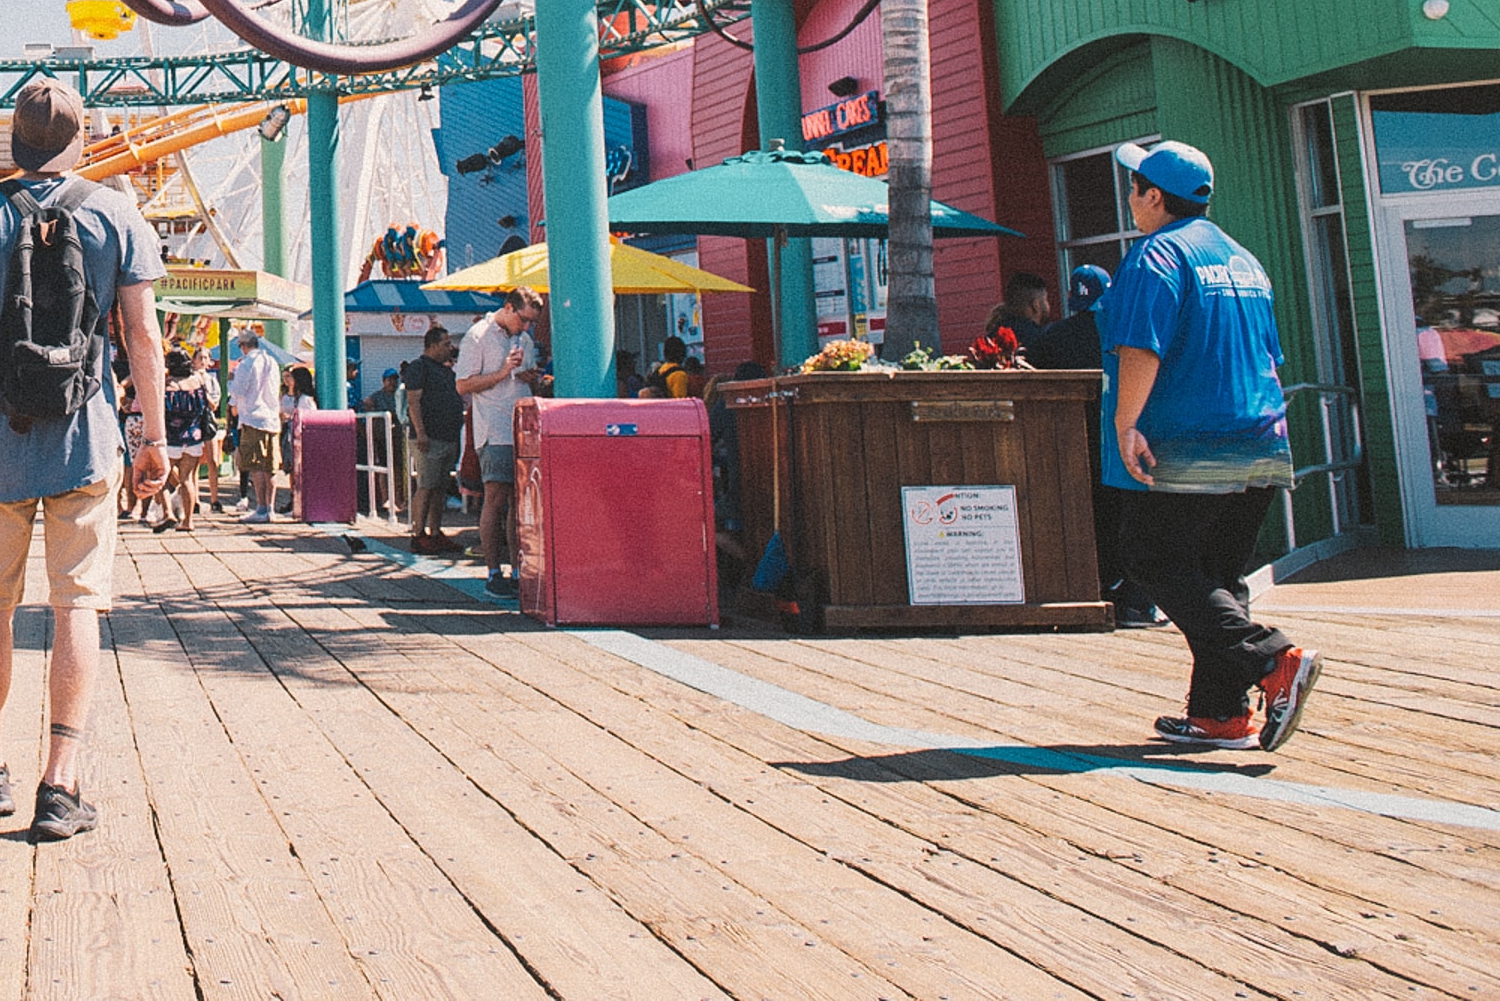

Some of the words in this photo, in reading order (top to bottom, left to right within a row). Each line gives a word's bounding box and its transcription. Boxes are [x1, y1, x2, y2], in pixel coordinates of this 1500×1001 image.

[801, 109, 834, 141] UNNEL
[836, 94, 871, 130] CAKES
[1401, 157, 1464, 189] The
[1470, 152, 1500, 182] C
[159, 277, 237, 291] #PACIFICPARK
[973, 504, 1009, 512] SMOKING
